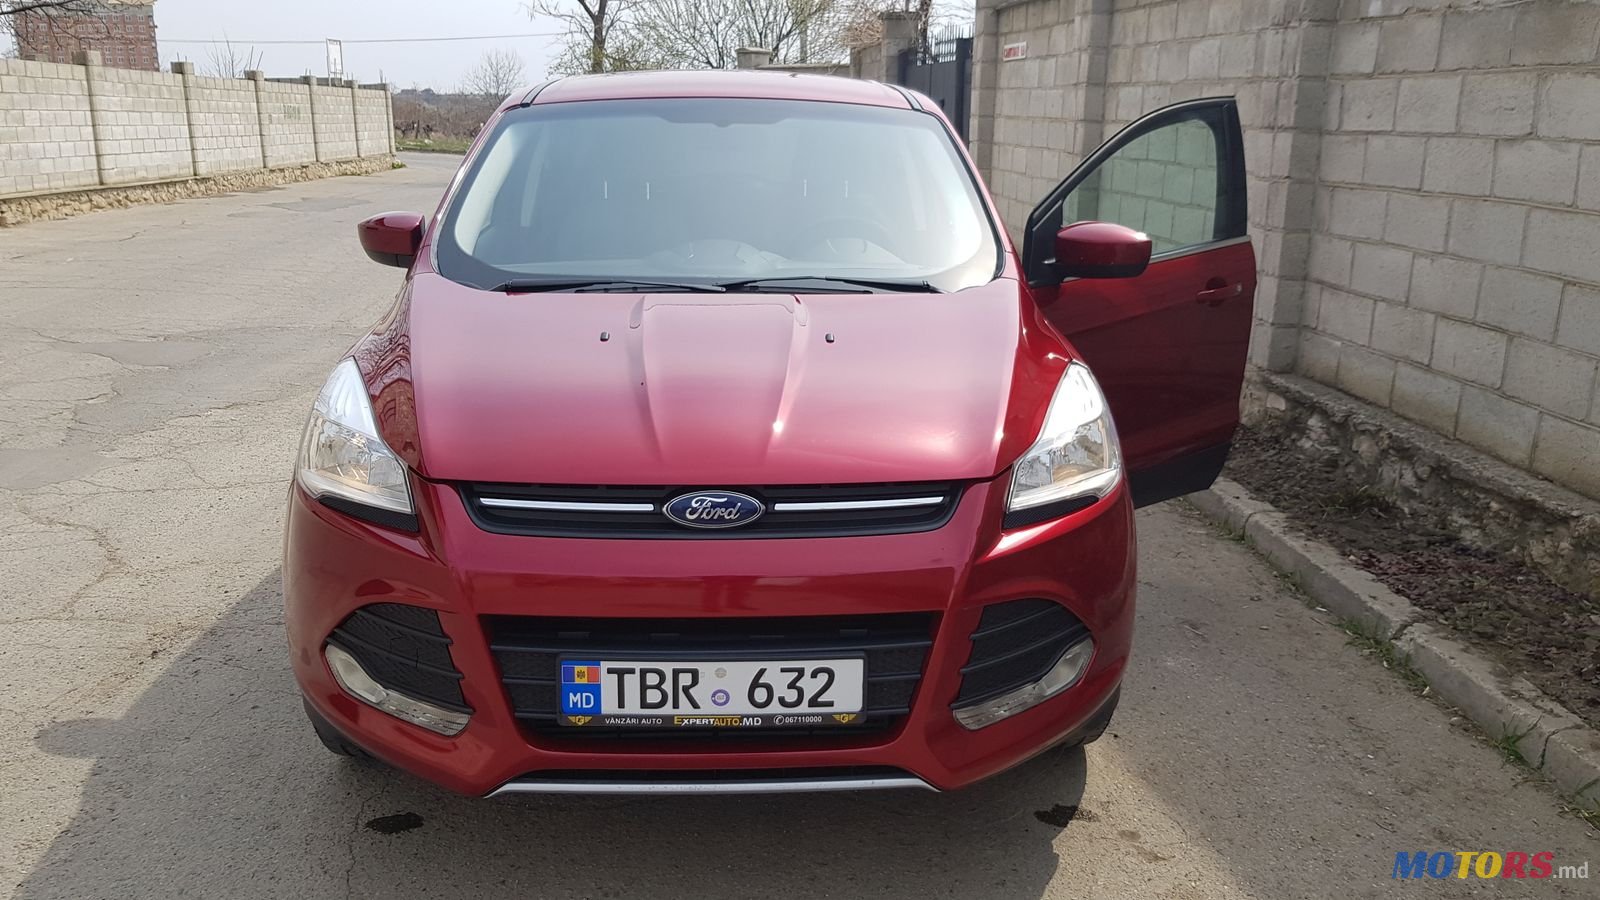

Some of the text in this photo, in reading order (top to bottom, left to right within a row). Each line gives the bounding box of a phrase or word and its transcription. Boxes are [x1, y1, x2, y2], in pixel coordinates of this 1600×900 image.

[685, 496, 741, 520] Ford
[606, 666, 836, 709] TBR 632
[569, 692, 594, 708] MD
[641, 717, 663, 725] AUTO
[784, 715, 823, 723] 067110000
